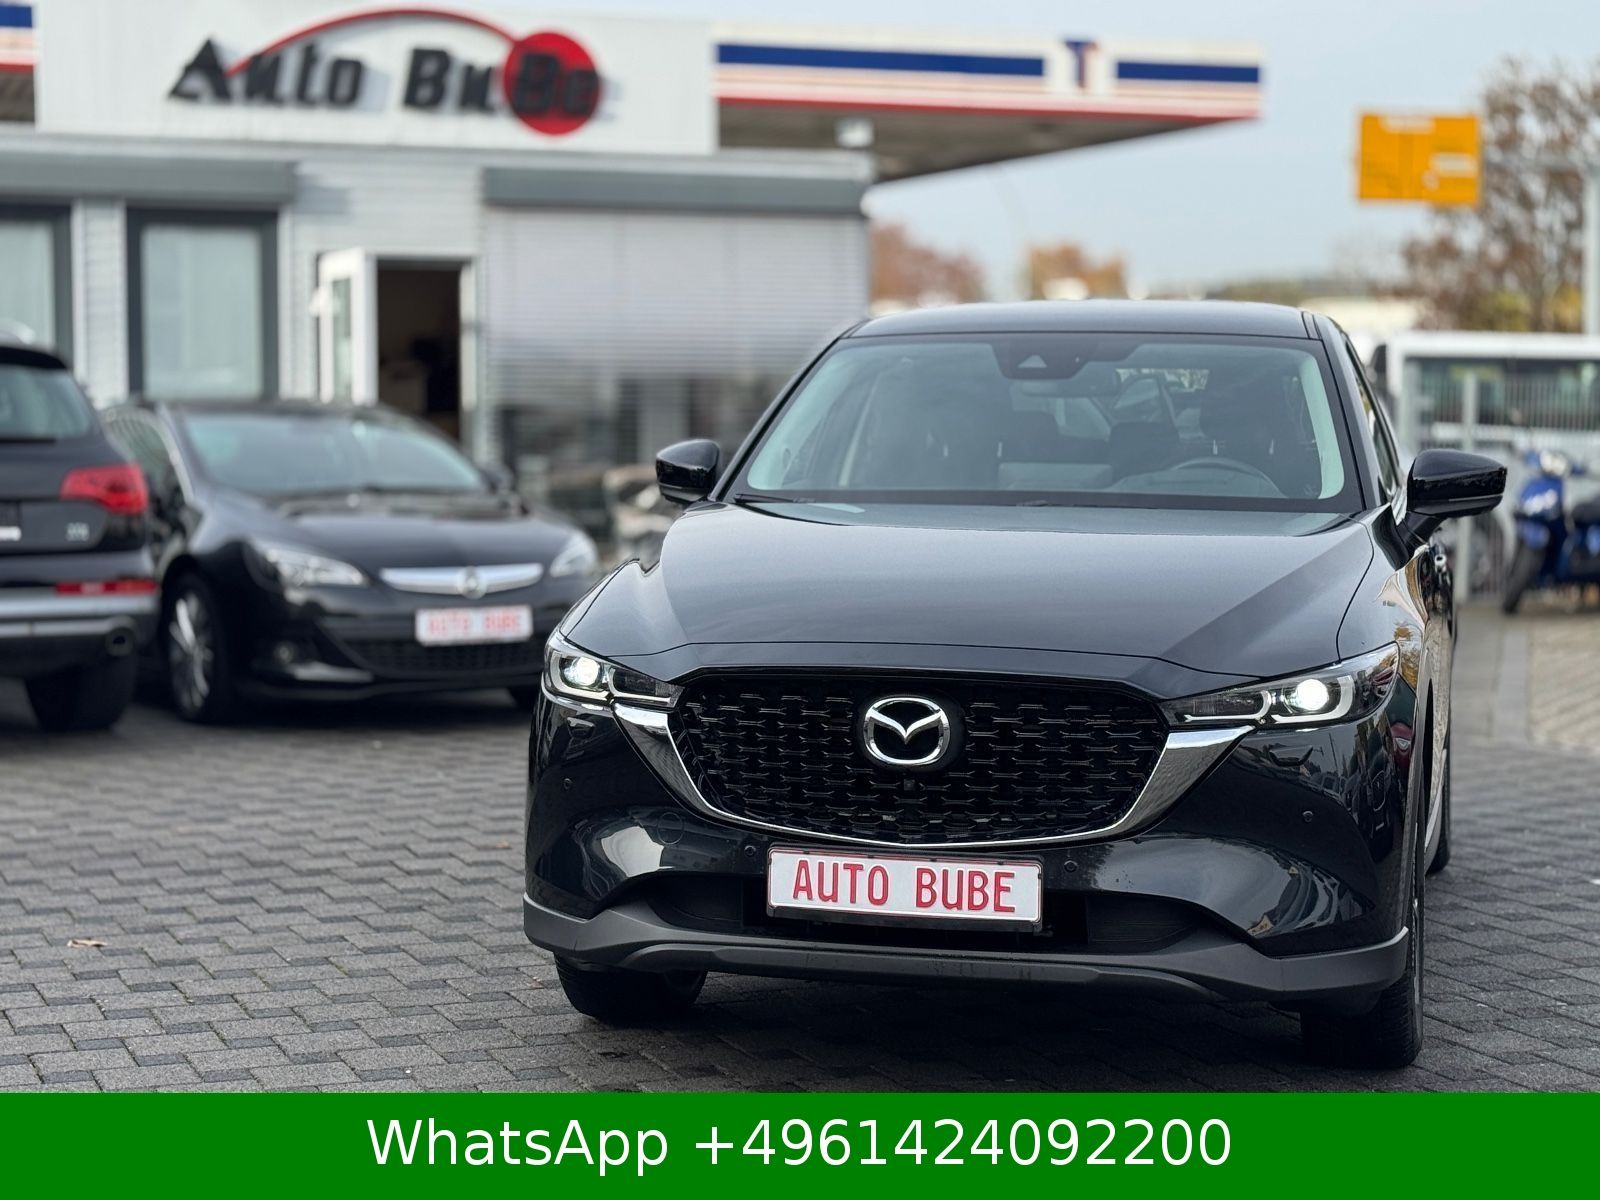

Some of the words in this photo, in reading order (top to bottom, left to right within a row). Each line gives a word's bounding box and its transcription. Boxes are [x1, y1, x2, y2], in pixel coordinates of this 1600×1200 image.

[168, 38, 365, 107] Auto
[793, 859, 889, 906] AUTO
[916, 867, 1015, 913] BUBE
